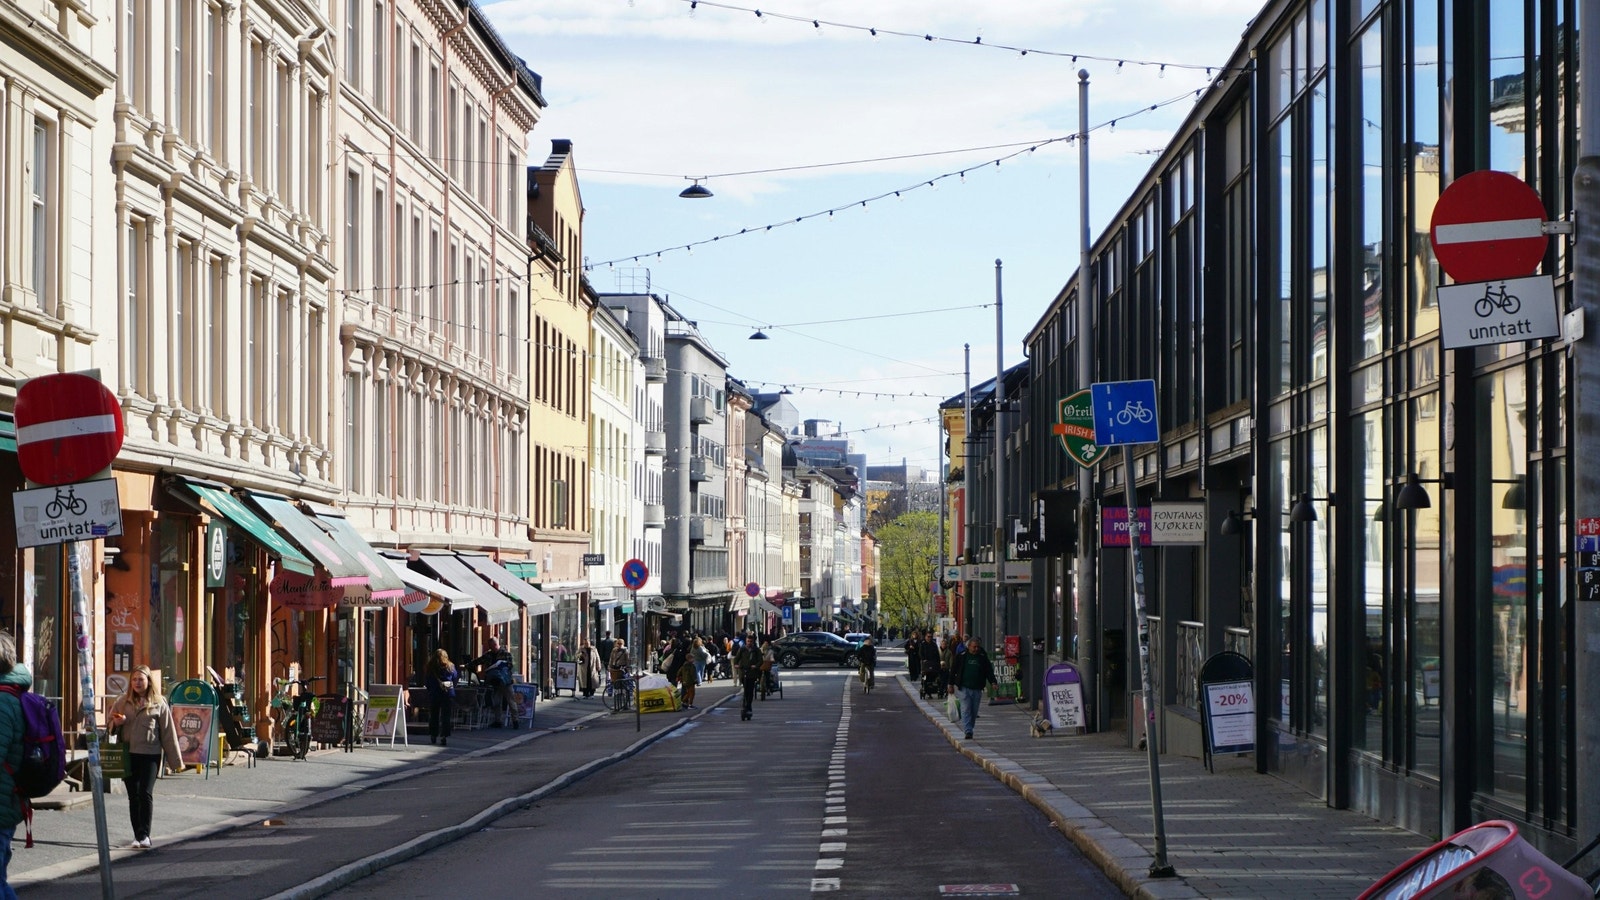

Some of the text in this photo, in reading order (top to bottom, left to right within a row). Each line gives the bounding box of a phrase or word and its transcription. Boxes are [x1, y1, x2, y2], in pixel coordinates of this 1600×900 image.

[1469, 319, 1532, 339] unntatt
[1065, 425, 1088, 437] IRISH
[1153, 511, 1203, 520] FONTANAS
[1154, 521, 1203, 531] KJØKKEN
[1215, 693, 1248, 706] -20%
[186, 720, 197, 729] FOR
